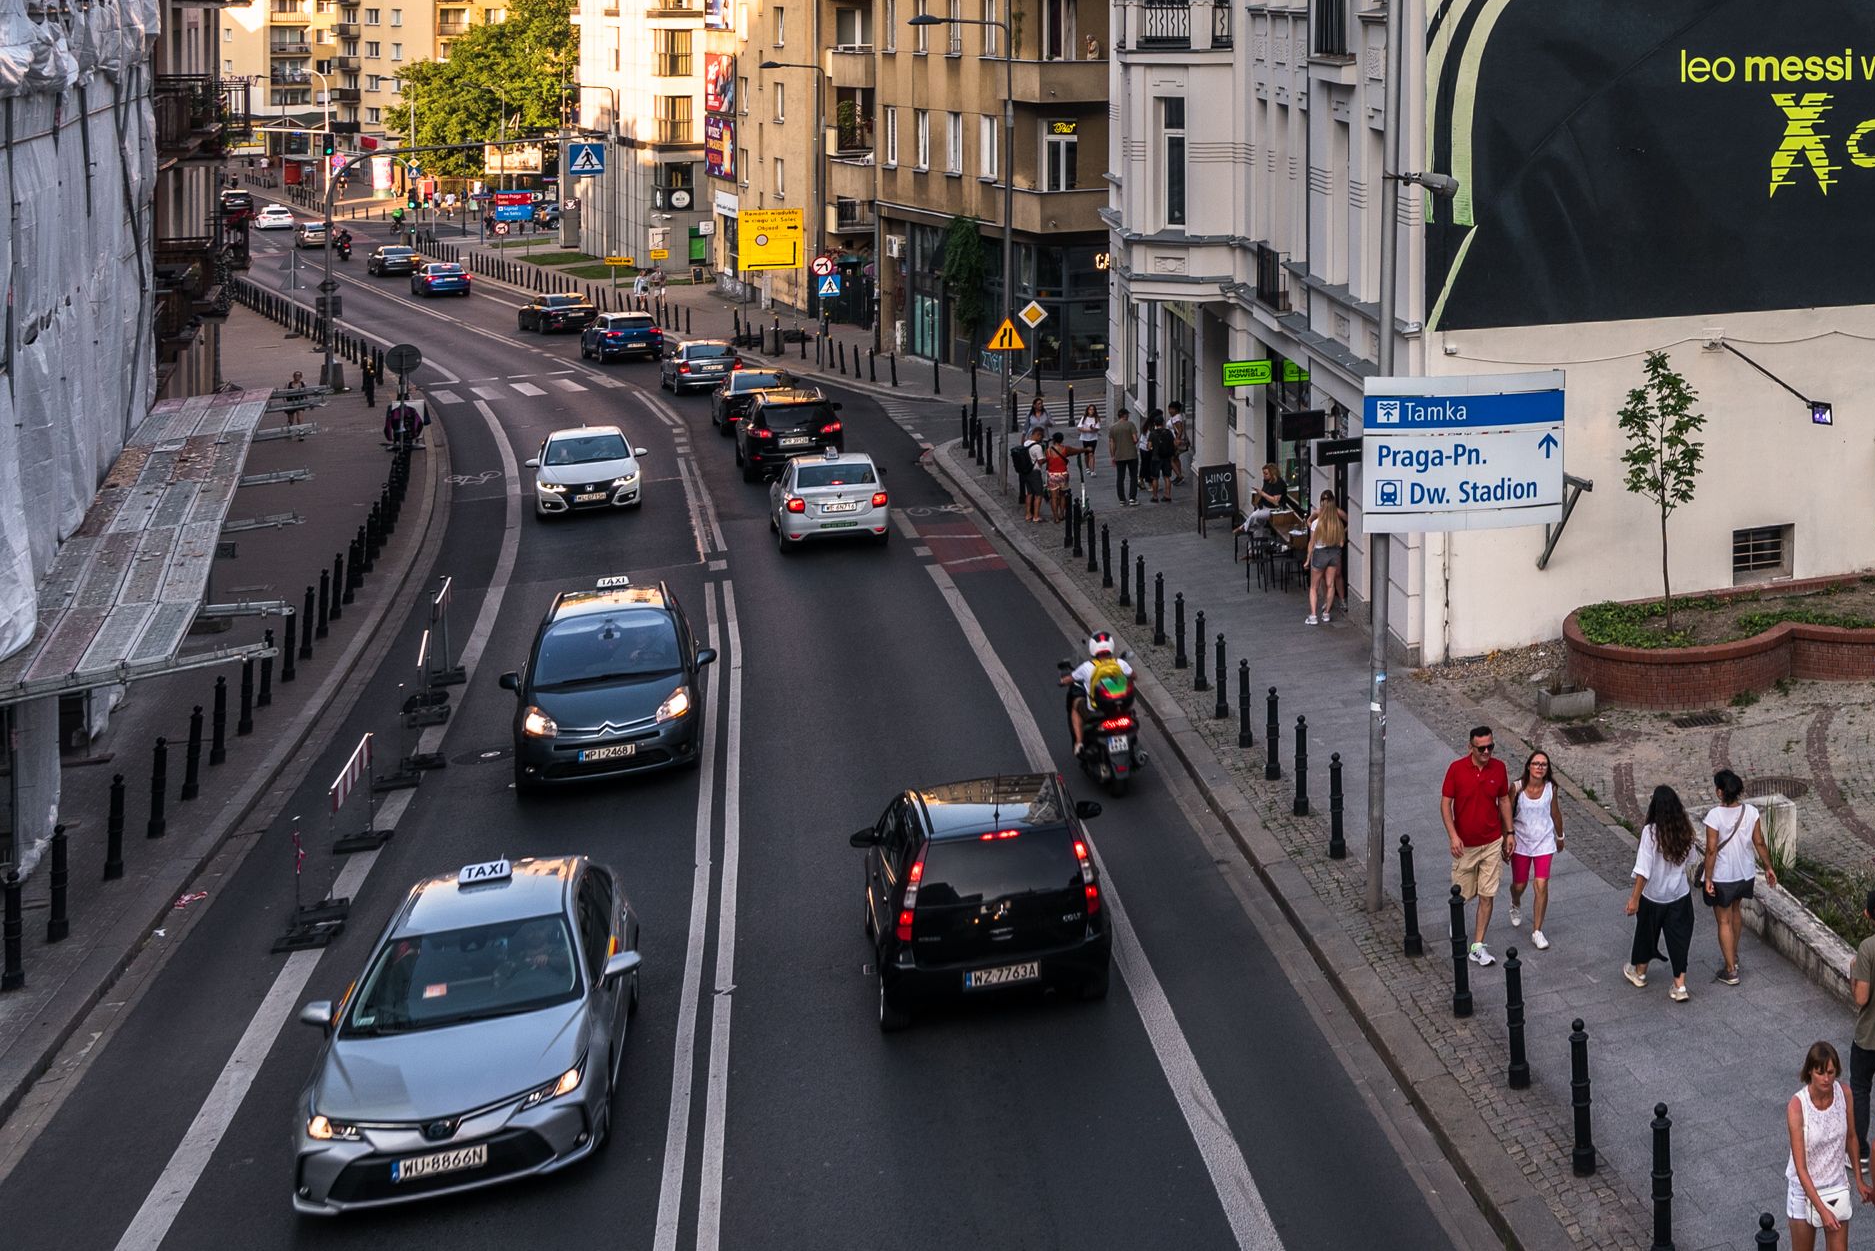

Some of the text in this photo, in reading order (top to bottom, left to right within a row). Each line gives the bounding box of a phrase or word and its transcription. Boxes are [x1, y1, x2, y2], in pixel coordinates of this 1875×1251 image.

[1681, 49, 1736, 83] leo
[1744, 48, 1852, 82] messi
[1405, 400, 1467, 422] Tamka
[1377, 443, 1487, 473] Praga-Pn.
[1205, 472, 1232, 484] WINO
[1410, 477, 1538, 505] Dw. Stadion
[601, 577, 625, 586] TAXI
[465, 862, 504, 879] TAXI
[997, 965, 1037, 982] 7763A
[431, 1147, 483, 1172] 8866N
